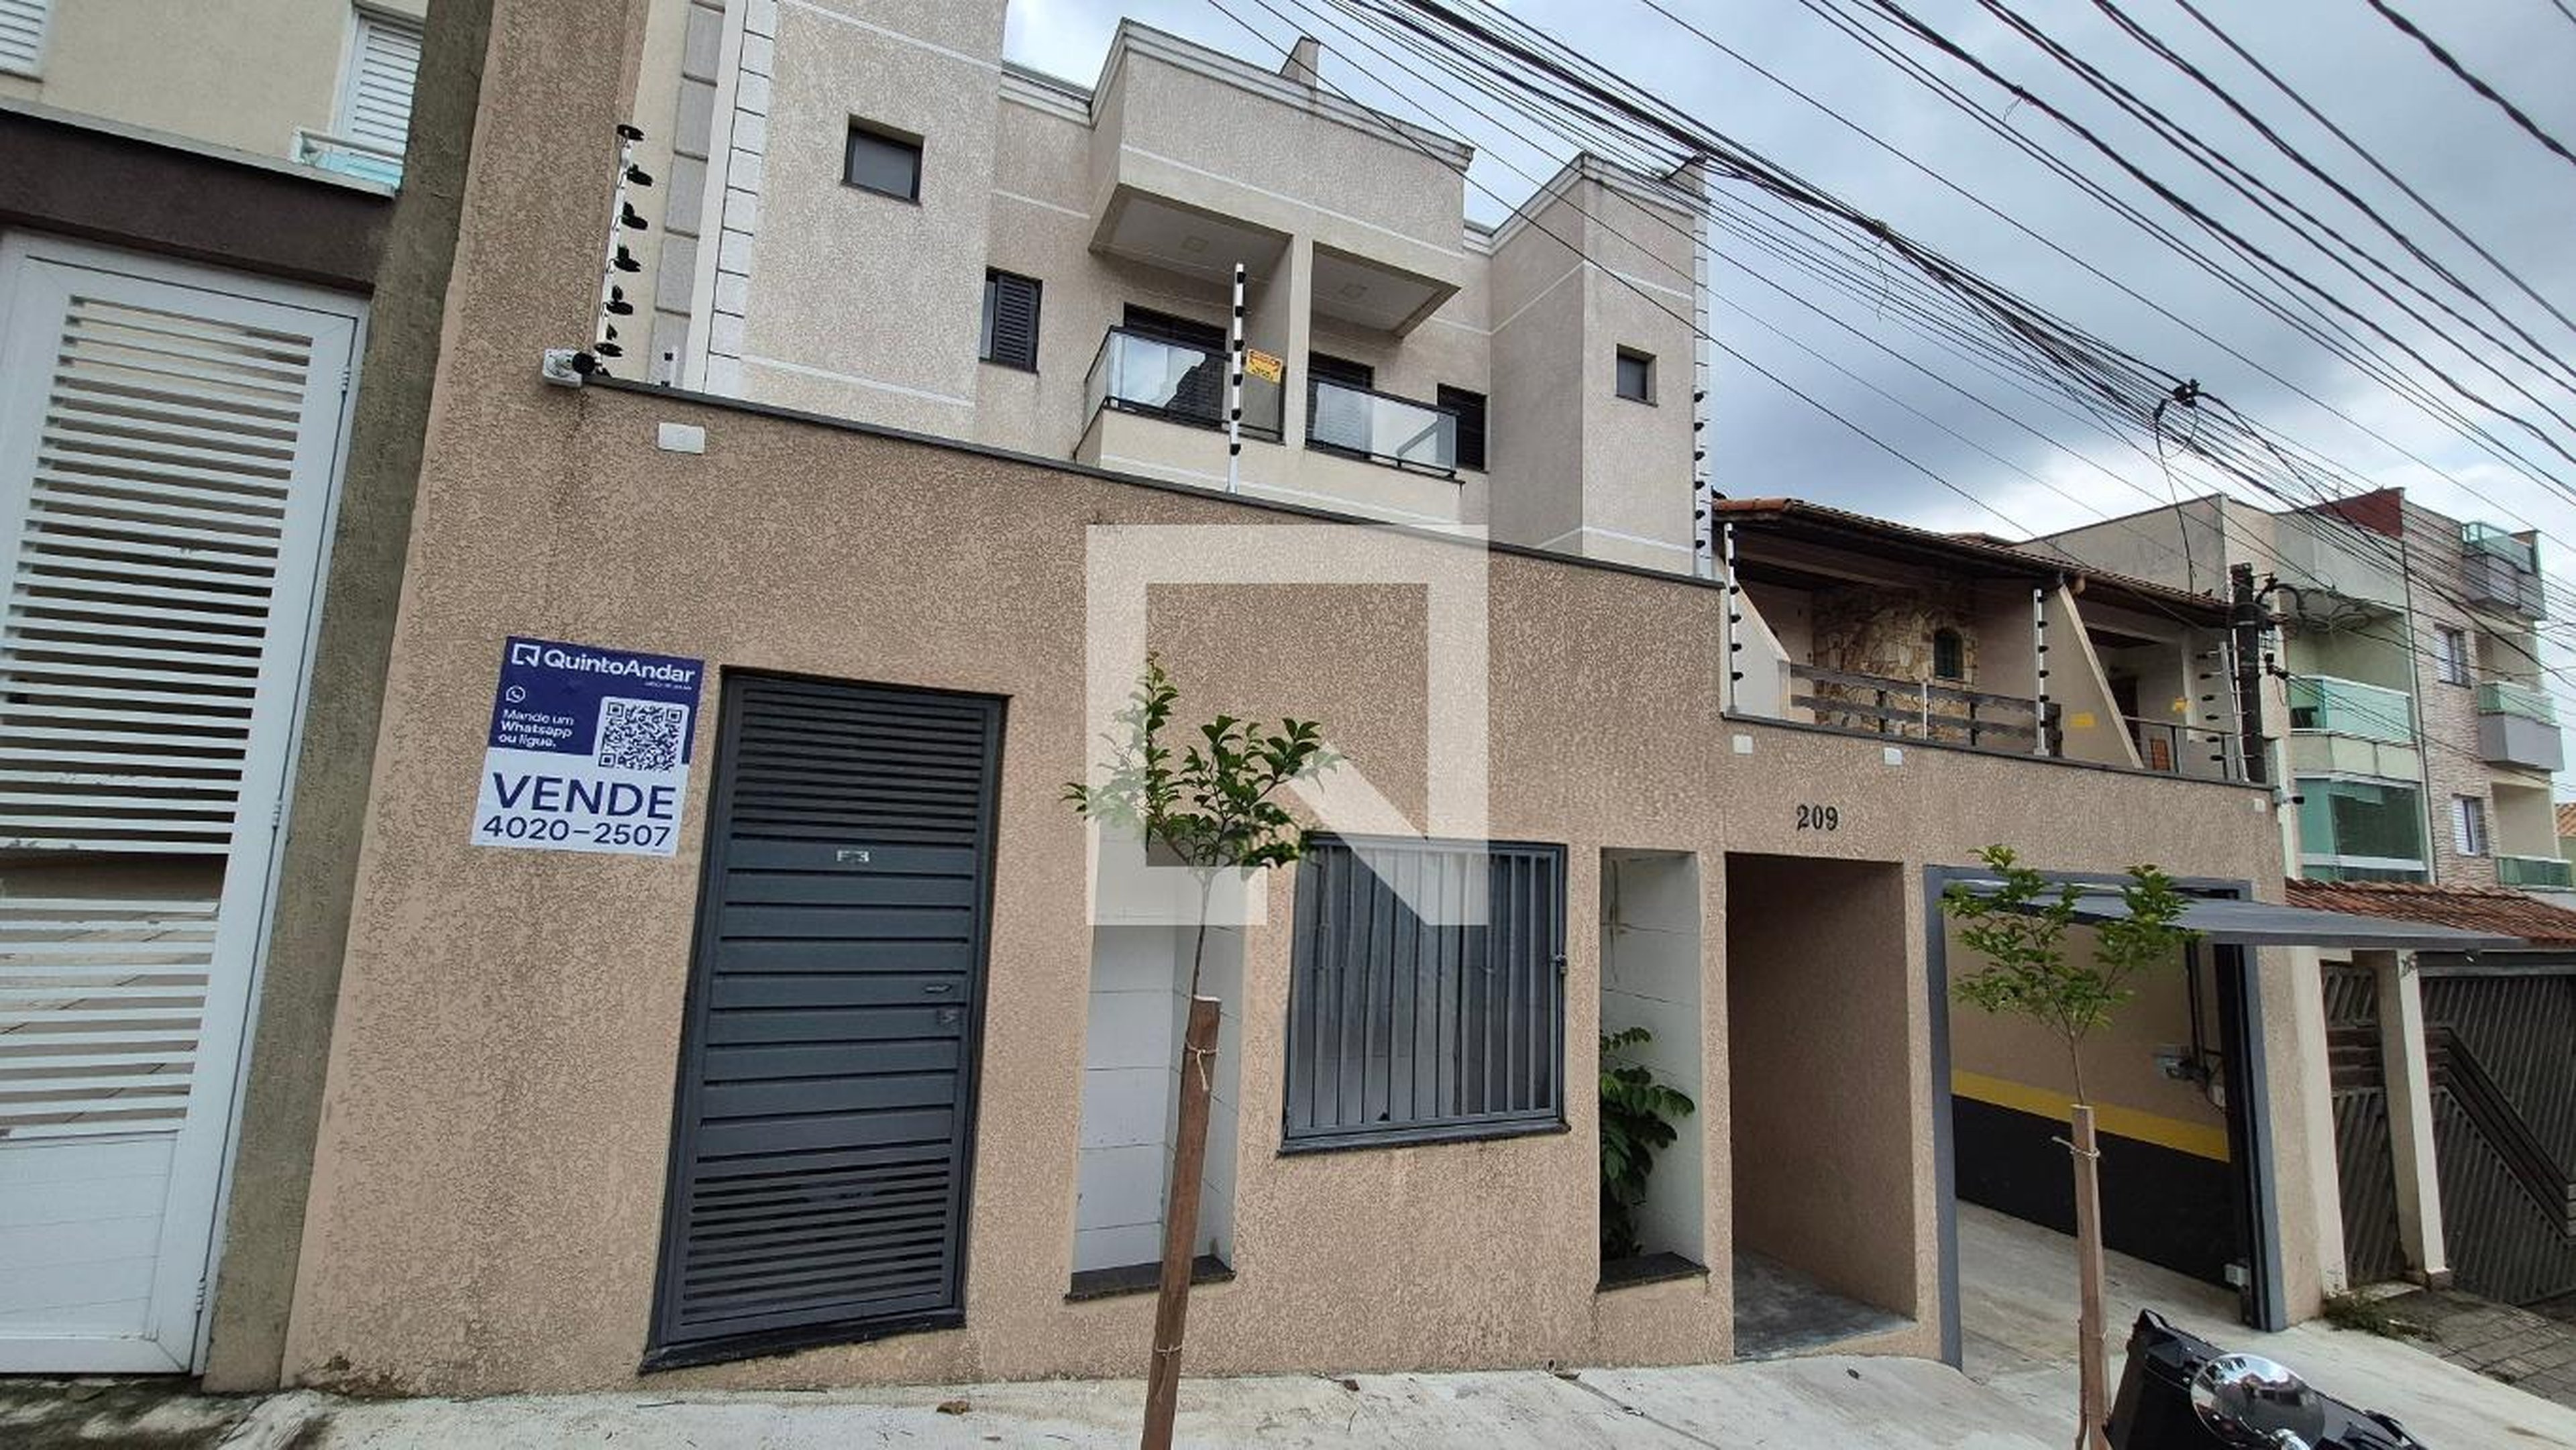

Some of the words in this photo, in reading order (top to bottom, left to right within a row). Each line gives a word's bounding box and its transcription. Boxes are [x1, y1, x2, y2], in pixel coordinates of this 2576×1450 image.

[544, 649, 695, 683] QuintoAndar
[501, 720, 572, 738] Whatsapp
[553, 716, 574, 726] um
[498, 734, 517, 742] ou
[493, 772, 676, 820] VENDE
[1797, 804, 1838, 830] 209
[483, 816, 670, 846] 4020-2507
